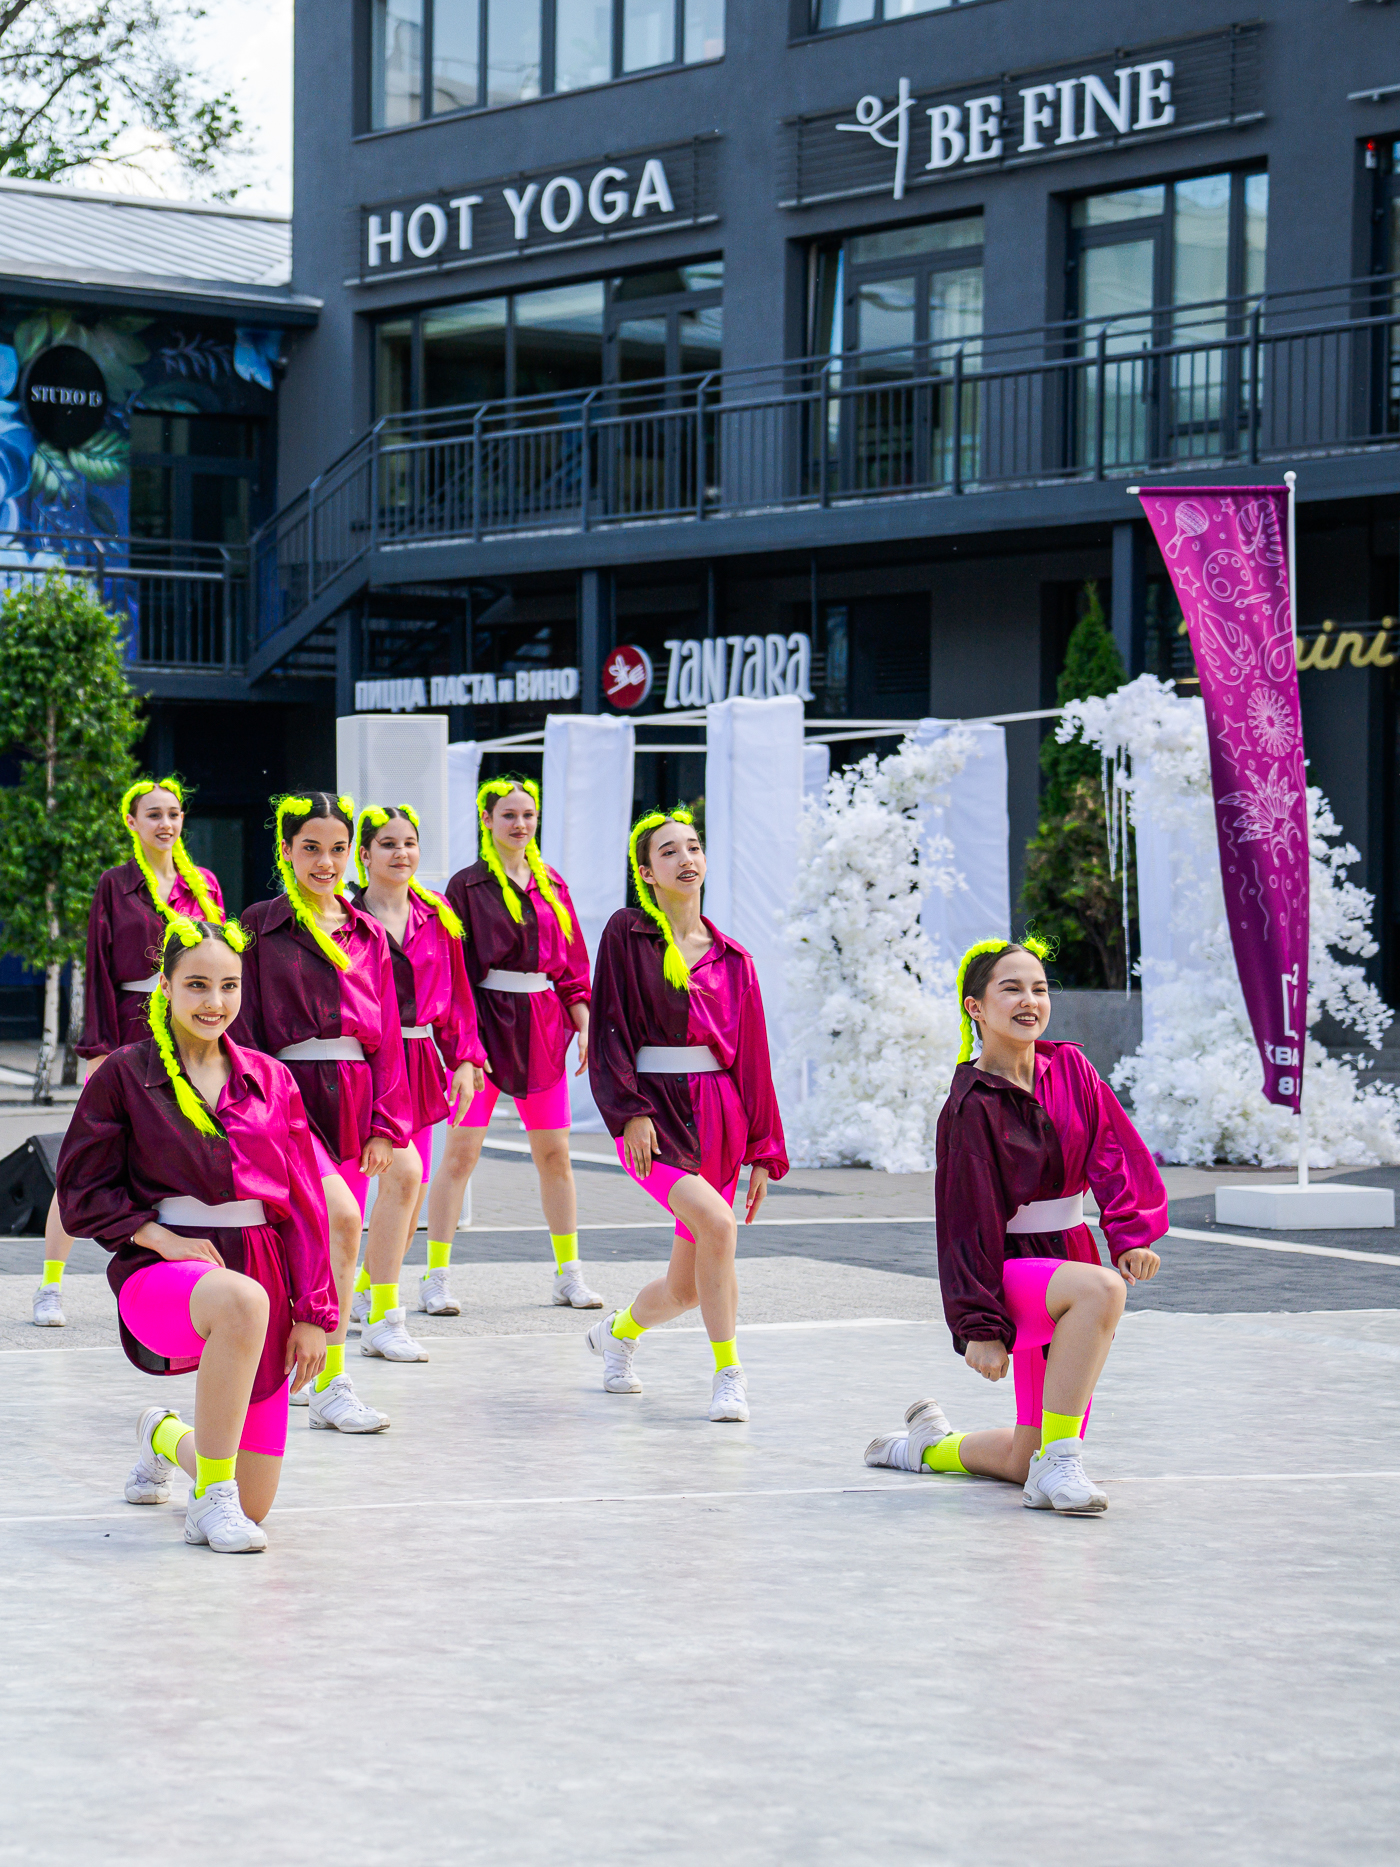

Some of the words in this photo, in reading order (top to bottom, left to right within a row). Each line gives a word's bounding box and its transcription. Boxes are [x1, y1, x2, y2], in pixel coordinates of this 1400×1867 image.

[925, 94, 1002, 171] BE
[1017, 59, 1176, 153] FINE
[368, 194, 483, 267] HOT
[502, 158, 675, 240] YOGA
[31, 384, 86, 406] STUDIO
[354, 677, 428, 713] ПИЦЦА
[430, 672, 497, 707] ПАСТА
[515, 667, 579, 702] ВИНО
